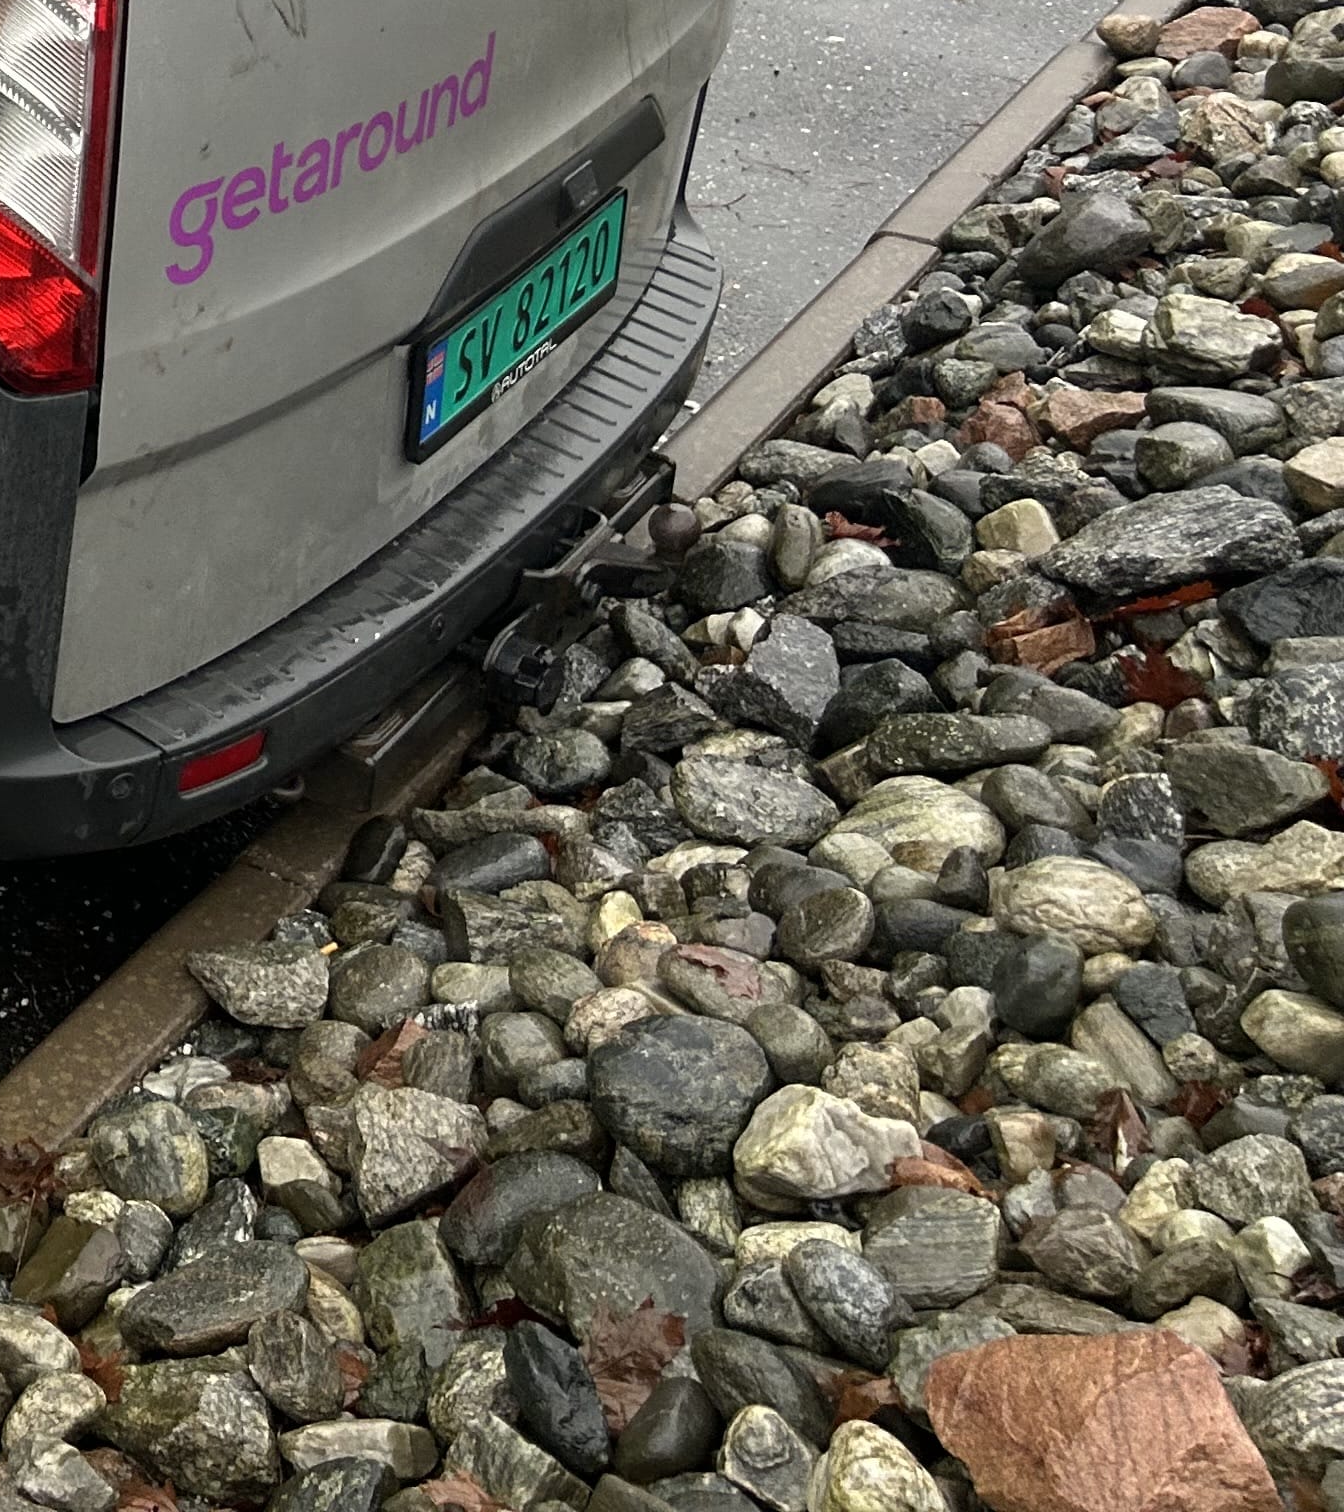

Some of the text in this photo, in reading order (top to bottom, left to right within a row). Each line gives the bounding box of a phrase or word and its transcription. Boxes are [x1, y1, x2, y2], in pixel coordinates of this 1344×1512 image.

[165, 30, 496, 286] getaround
[454, 219, 610, 404] SV 82120
[424, 400, 438, 425] N
